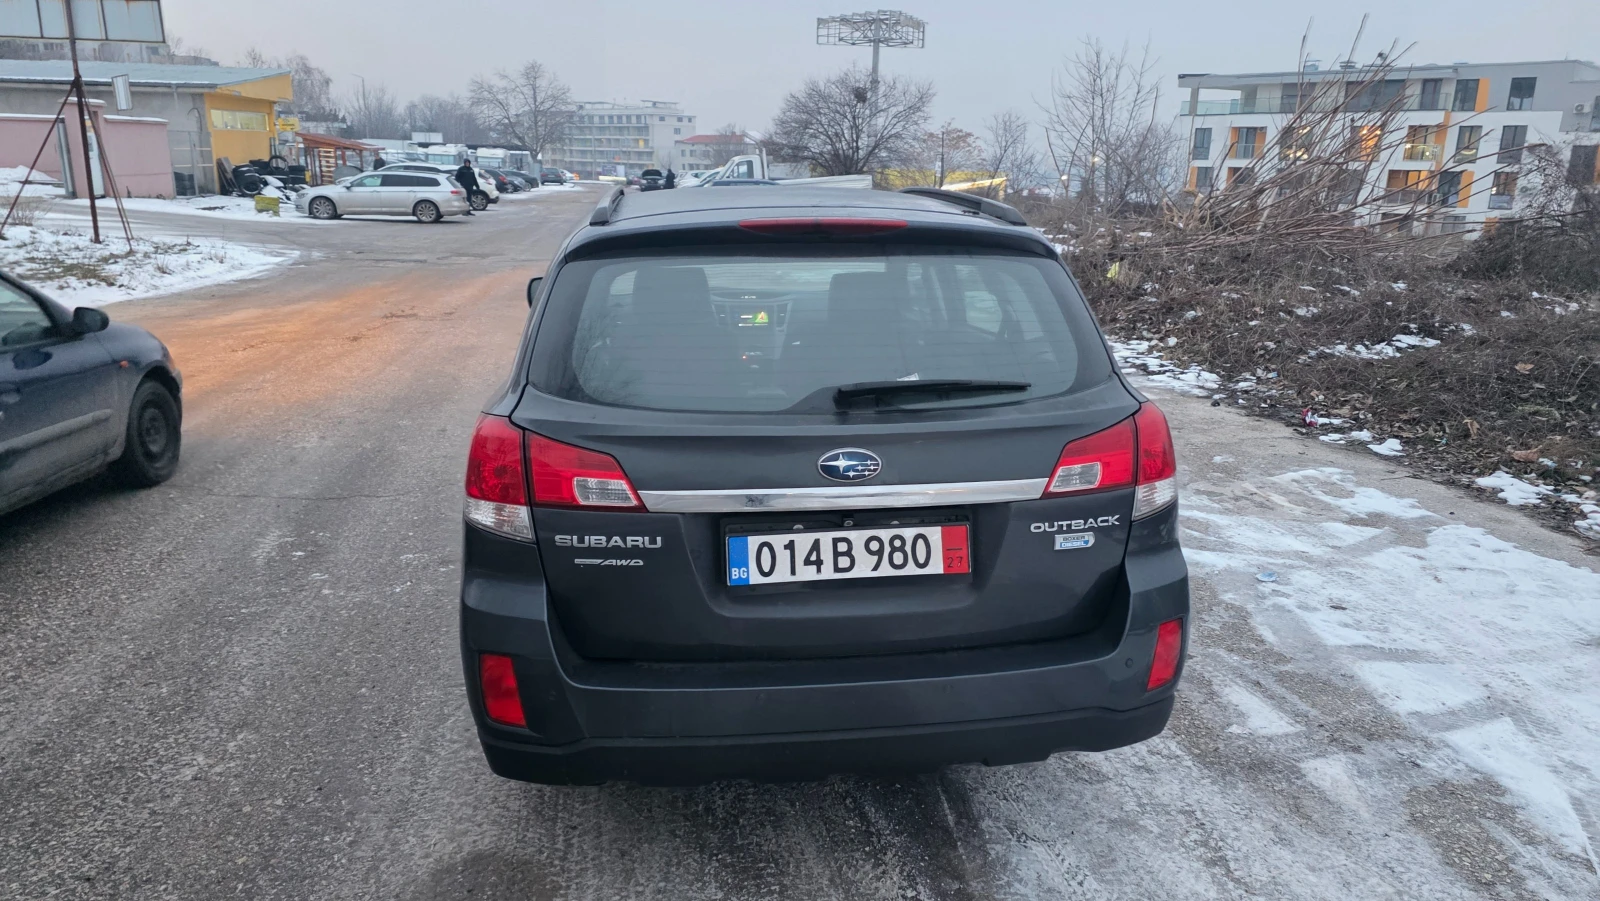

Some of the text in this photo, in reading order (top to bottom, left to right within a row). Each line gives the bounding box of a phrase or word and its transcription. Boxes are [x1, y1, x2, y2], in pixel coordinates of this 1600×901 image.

[1030, 514, 1121, 533] OUTBACK
[554, 534, 662, 549] SUBARU
[947, 556, 963, 568] 27
[731, 567, 748, 579] BG
